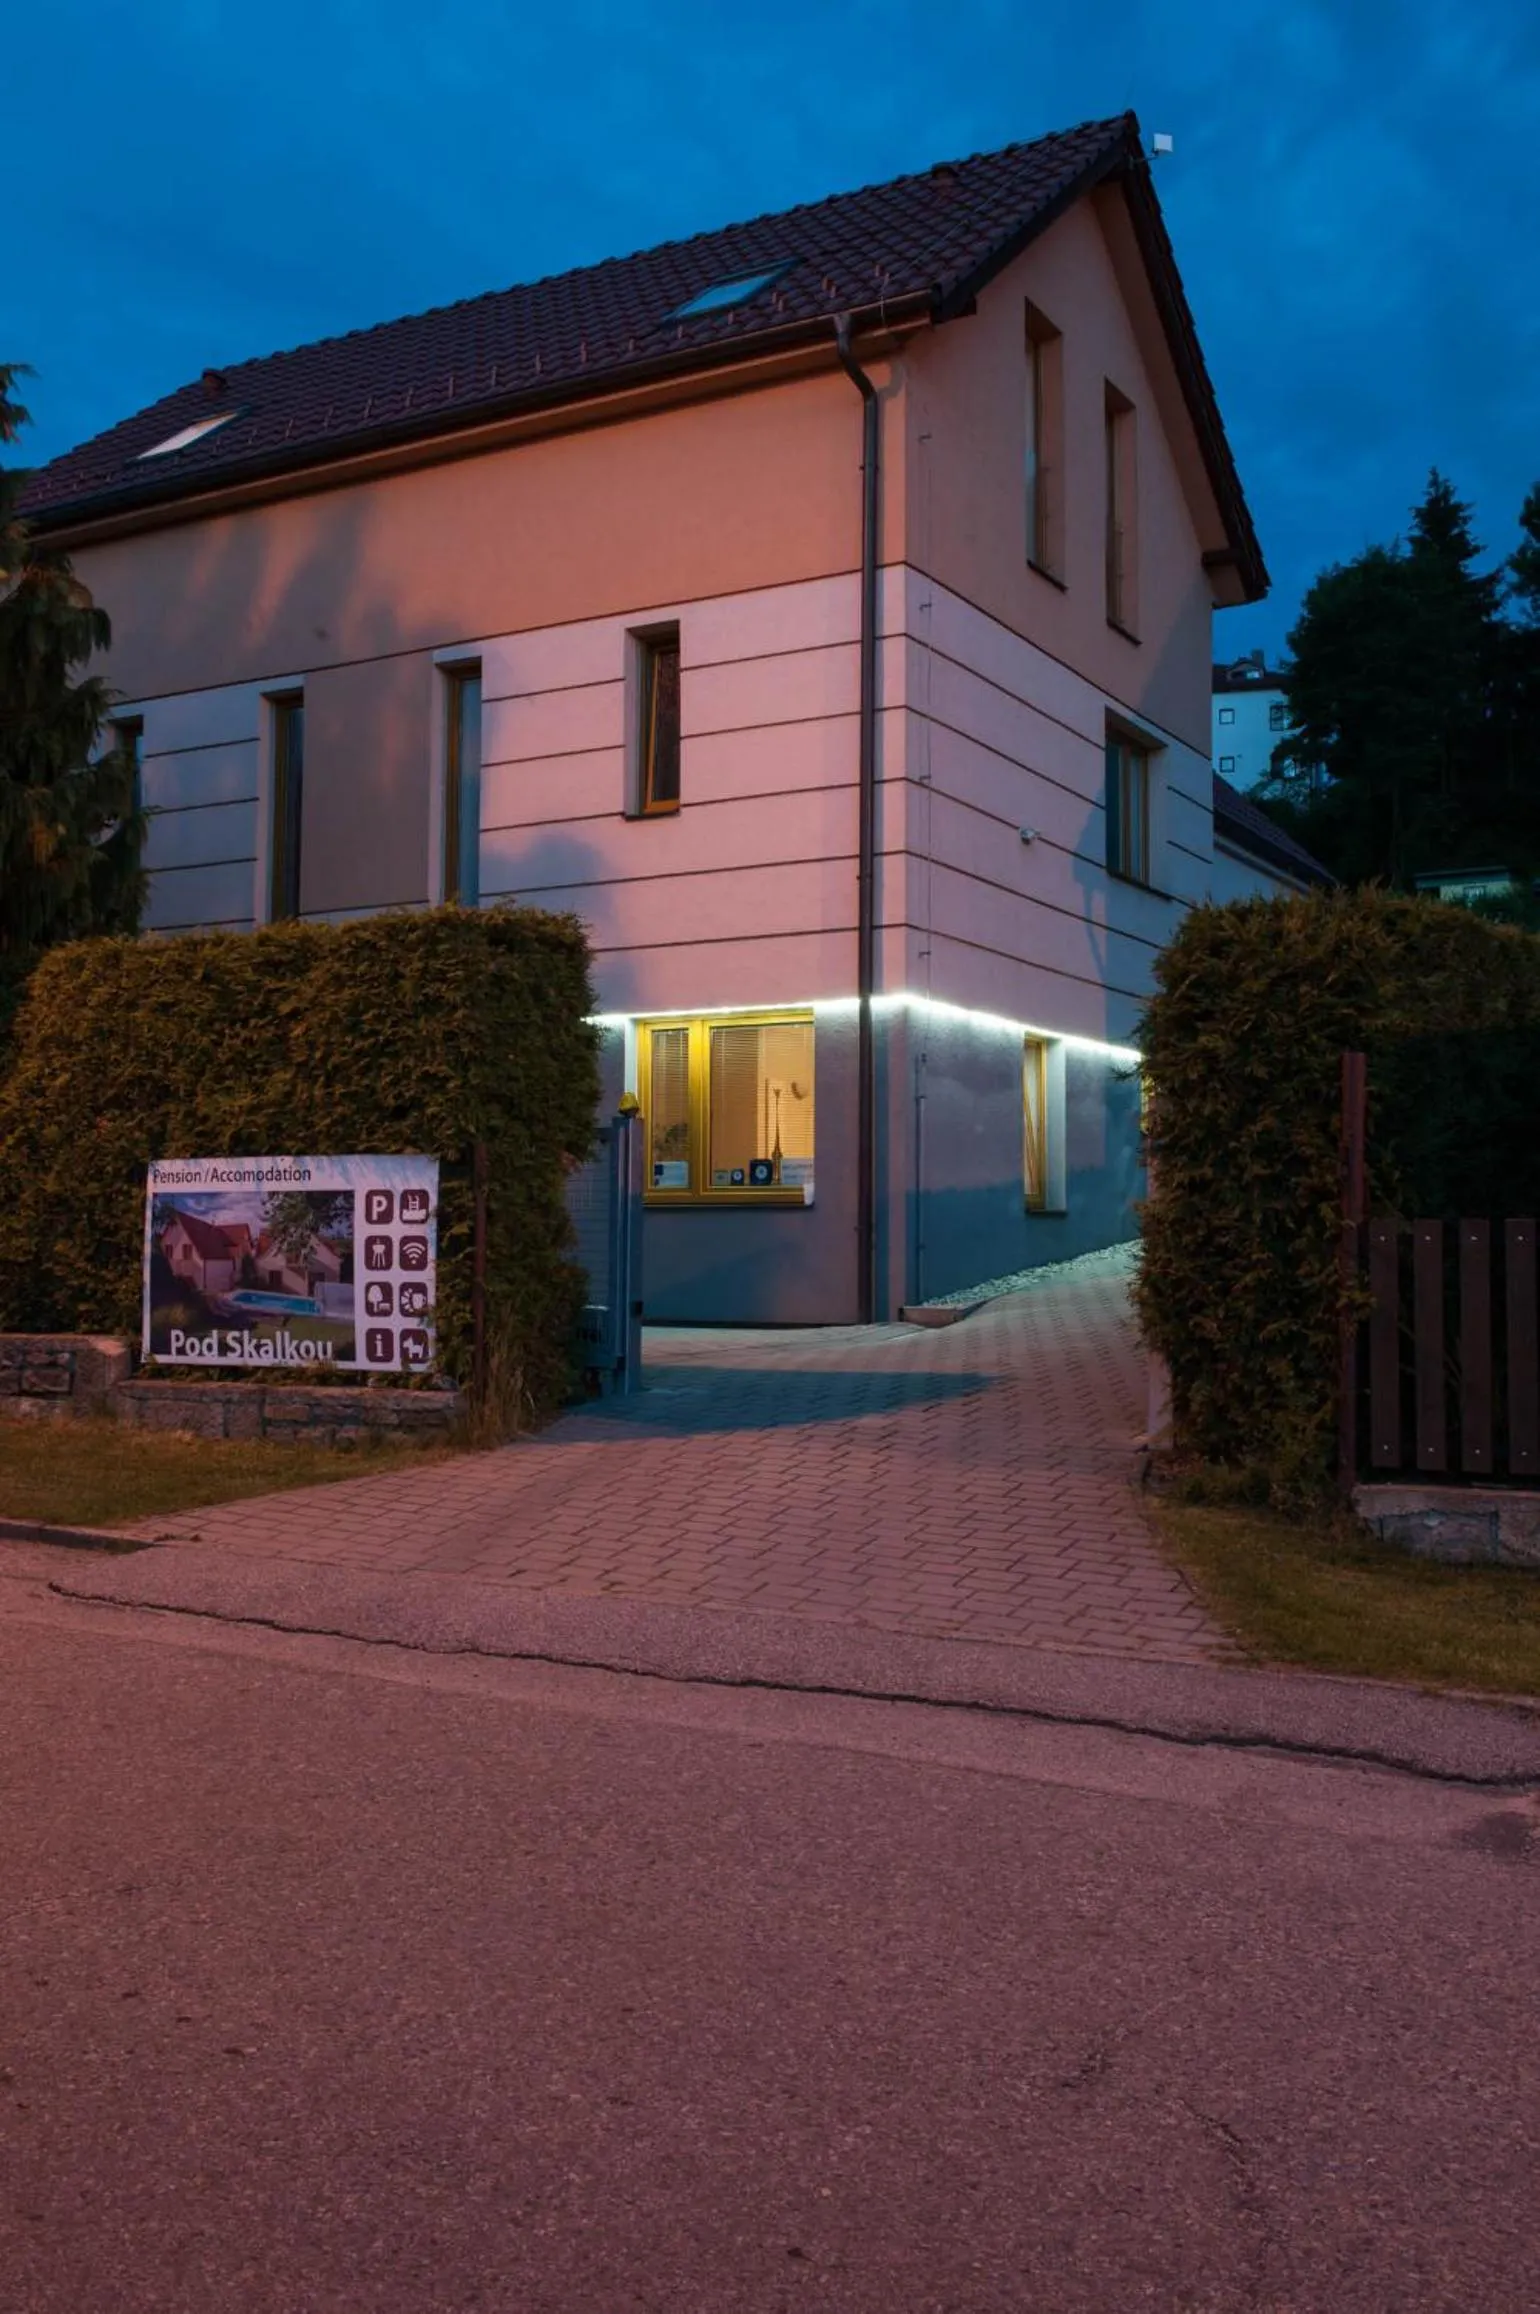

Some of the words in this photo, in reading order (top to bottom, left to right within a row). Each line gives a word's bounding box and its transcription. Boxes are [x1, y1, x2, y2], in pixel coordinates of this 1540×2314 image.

[372, 1195, 388, 1221] P
[170, 1329, 219, 1358] Pod
[226, 1330, 333, 1361] Skalkou
